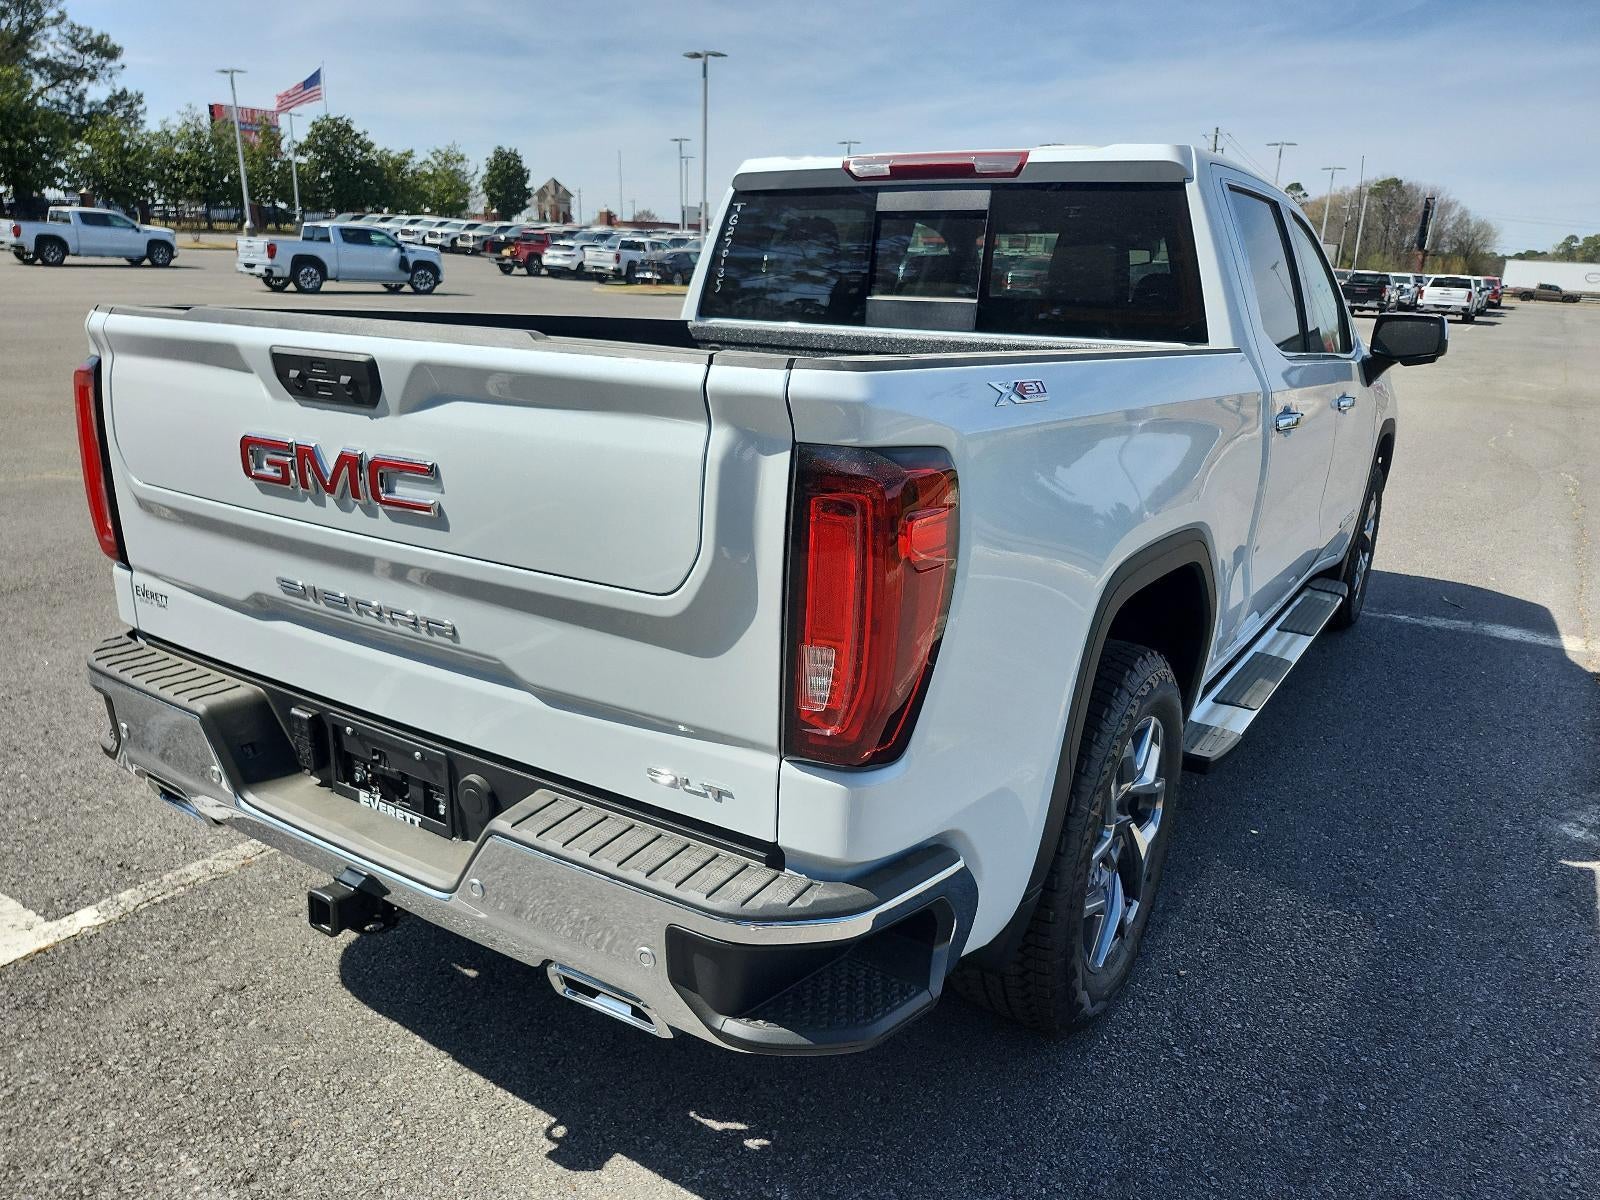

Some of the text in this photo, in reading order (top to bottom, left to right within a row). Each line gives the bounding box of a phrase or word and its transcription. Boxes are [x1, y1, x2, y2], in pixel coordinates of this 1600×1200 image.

[240, 432, 440, 517] GMC
[135, 583, 168, 604] EVERETT
[276, 576, 457, 640] SIERRA
[646, 767, 735, 804] SLT
[359, 790, 422, 828] EVERETT
